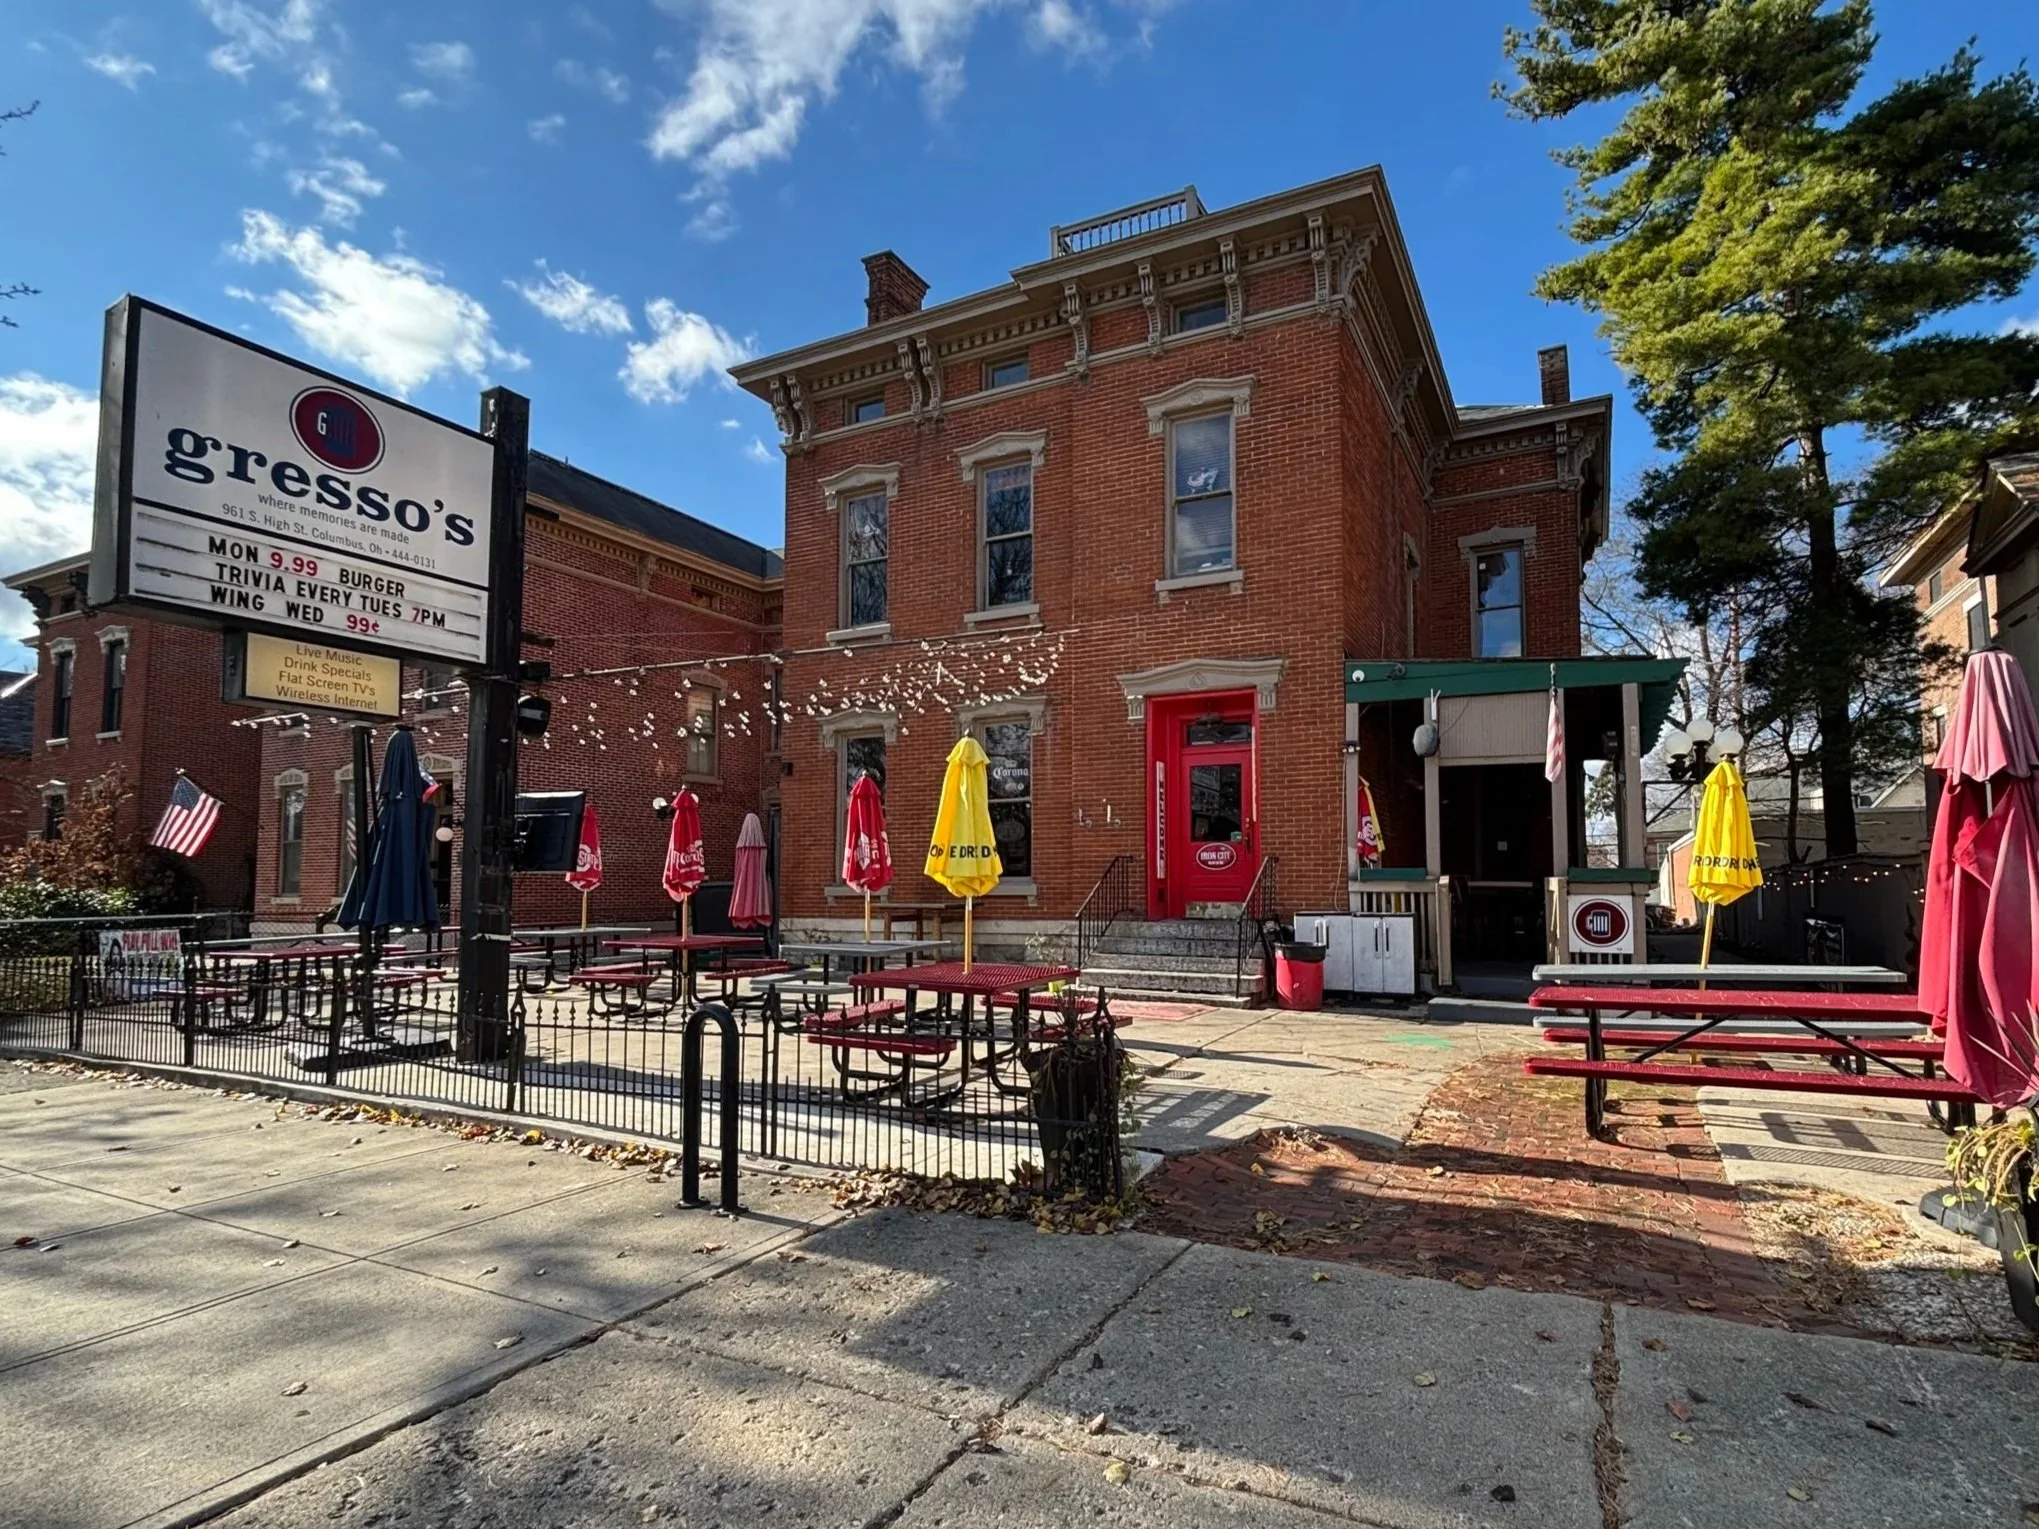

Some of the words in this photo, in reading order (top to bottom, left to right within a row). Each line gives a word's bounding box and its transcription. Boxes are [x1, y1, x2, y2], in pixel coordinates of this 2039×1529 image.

[164, 428, 474, 546] gresso's
[222, 503, 244, 519] 961
[249, 510, 260, 523] S.
[264, 514, 290, 531] High
[293, 522, 308, 536] St.
[369, 542, 383, 555] Oh
[392, 548, 436, 569] 444-0131
[258, 494, 296, 512] where
[300, 506, 356, 529] memories
[360, 523, 378, 535] are
[381, 528, 410, 544] made
[208, 535, 258, 563] MON
[269, 551, 319, 577] 9.99
[340, 567, 405, 598] BURGER
[210, 584, 265, 611] WING
[286, 600, 324, 623] WED
[346, 614, 380, 634] 99¢
[215, 562, 286, 594] TRIVIA
[296, 580, 352, 607] EVERY
[360, 594, 402, 618] TUES
[412, 607, 446, 628] 7PM
[284, 656, 318, 673] Drink
[321, 663, 372, 681] Specials
[296, 644, 322, 659] Live
[326, 649, 363, 666] Music
[276, 684, 330, 703] Wireless
[334, 694, 378, 710] Internet
[279, 670, 302, 685] Flat
[306, 675, 348, 691] Screen
[352, 681, 376, 696] TV's
[992, 766, 1029, 779] Corona
[1200, 851, 1216, 861] IRON
[1217, 851, 1231, 861] CITY
